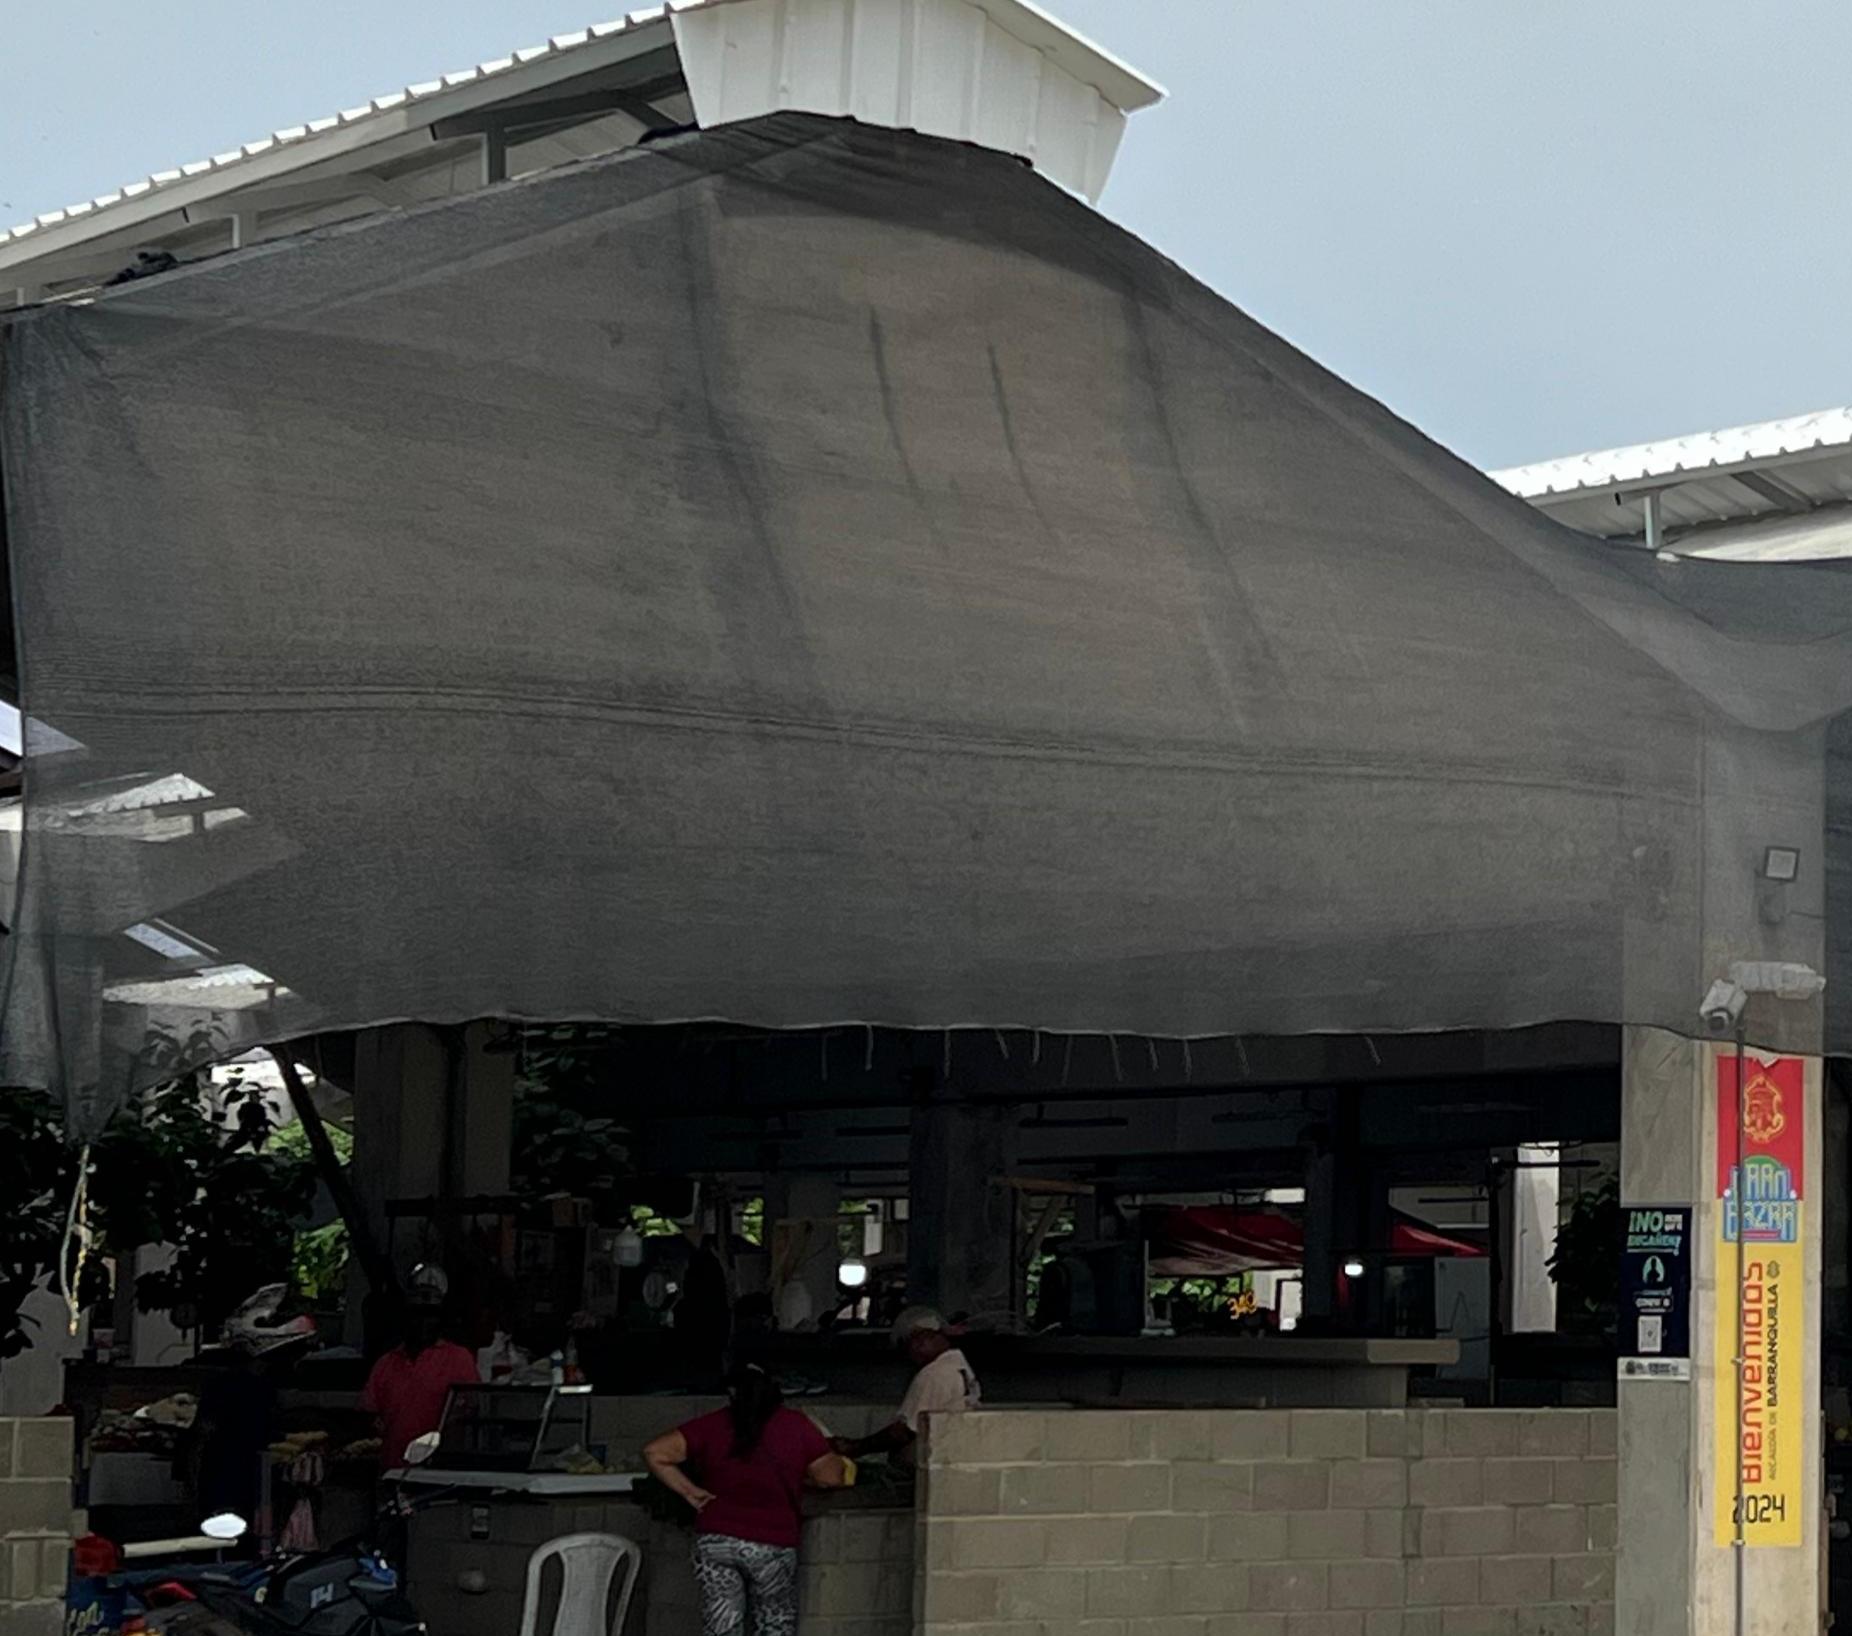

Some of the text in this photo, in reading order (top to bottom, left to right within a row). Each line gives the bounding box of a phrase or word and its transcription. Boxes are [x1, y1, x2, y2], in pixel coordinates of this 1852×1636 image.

[1741, 1262, 1763, 1484] Bienvenidos
[1766, 1283, 1779, 1408] BARRANQUILLA
[1732, 1493, 1786, 1524] 2024
